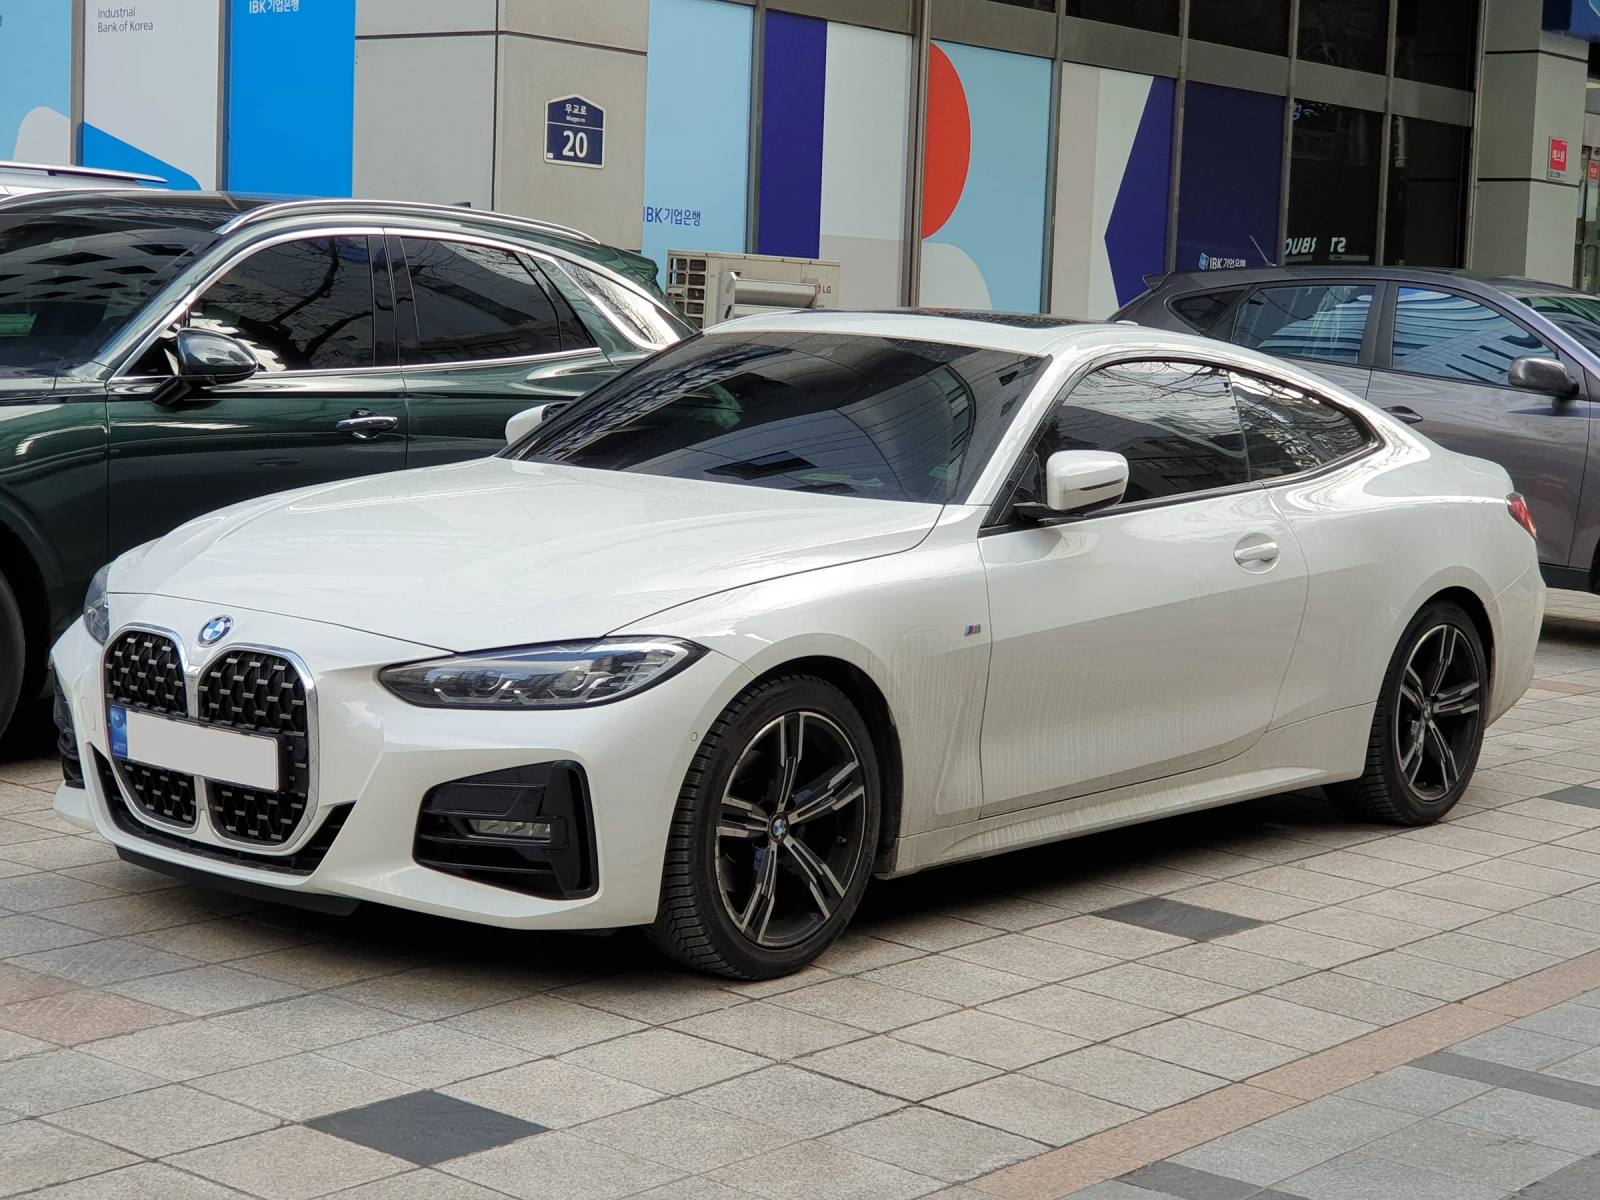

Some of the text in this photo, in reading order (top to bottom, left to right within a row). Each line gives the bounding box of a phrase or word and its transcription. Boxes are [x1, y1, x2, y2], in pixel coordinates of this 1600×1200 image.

[97, 6, 136, 18] Industrial
[97, 20, 154, 33] Bank of Korea
[564, 103, 587, 115] 무교로
[562, 130, 588, 158] 20
[822, 285, 832, 294] LG
